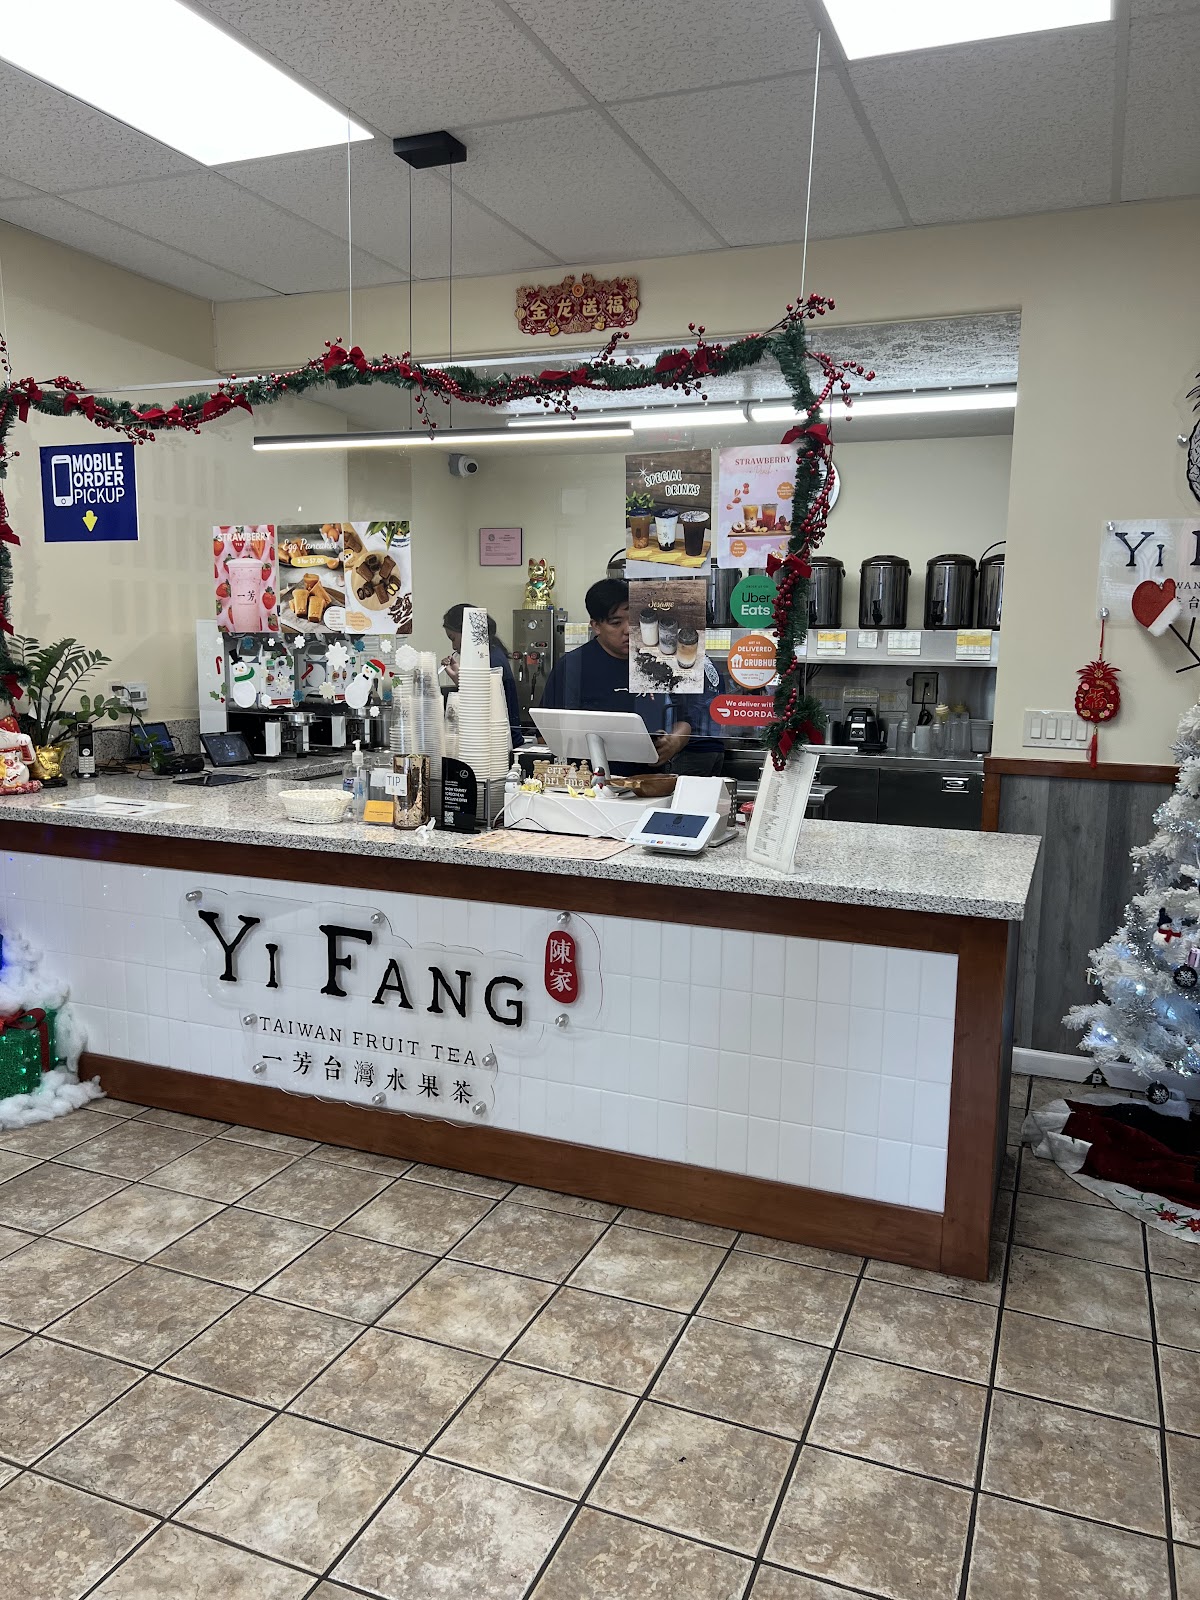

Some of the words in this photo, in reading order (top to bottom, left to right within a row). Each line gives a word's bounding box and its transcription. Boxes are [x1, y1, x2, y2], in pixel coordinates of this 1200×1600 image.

[530, 295, 624, 321] 金龙送福
[73, 452, 123, 472] MOBILE
[735, 456, 792, 465] STRAWBERRY
[74, 471, 125, 488] ORDER
[644, 470, 682, 487] SPECIAL
[74, 487, 126, 505] PICKUP
[665, 484, 701, 496] DRINKS
[218, 532, 271, 541] STRAWBERRY
[282, 539, 298, 553] Egg
[300, 538, 337, 550] Pancakes
[741, 593, 771, 603] Uber
[741, 604, 770, 615] Eats
[737, 700, 760, 708] deliver
[387, 776, 401, 786] TIP
[549, 938, 574, 993] 陳家
[318, 924, 525, 1028] FANG
[260, 1015, 343, 1043] TAIWAN
[352, 1031, 420, 1056] FRUIT
[432, 1044, 477, 1067] TEA
[262, 1050, 474, 1105] 一芳台灣水果茶
